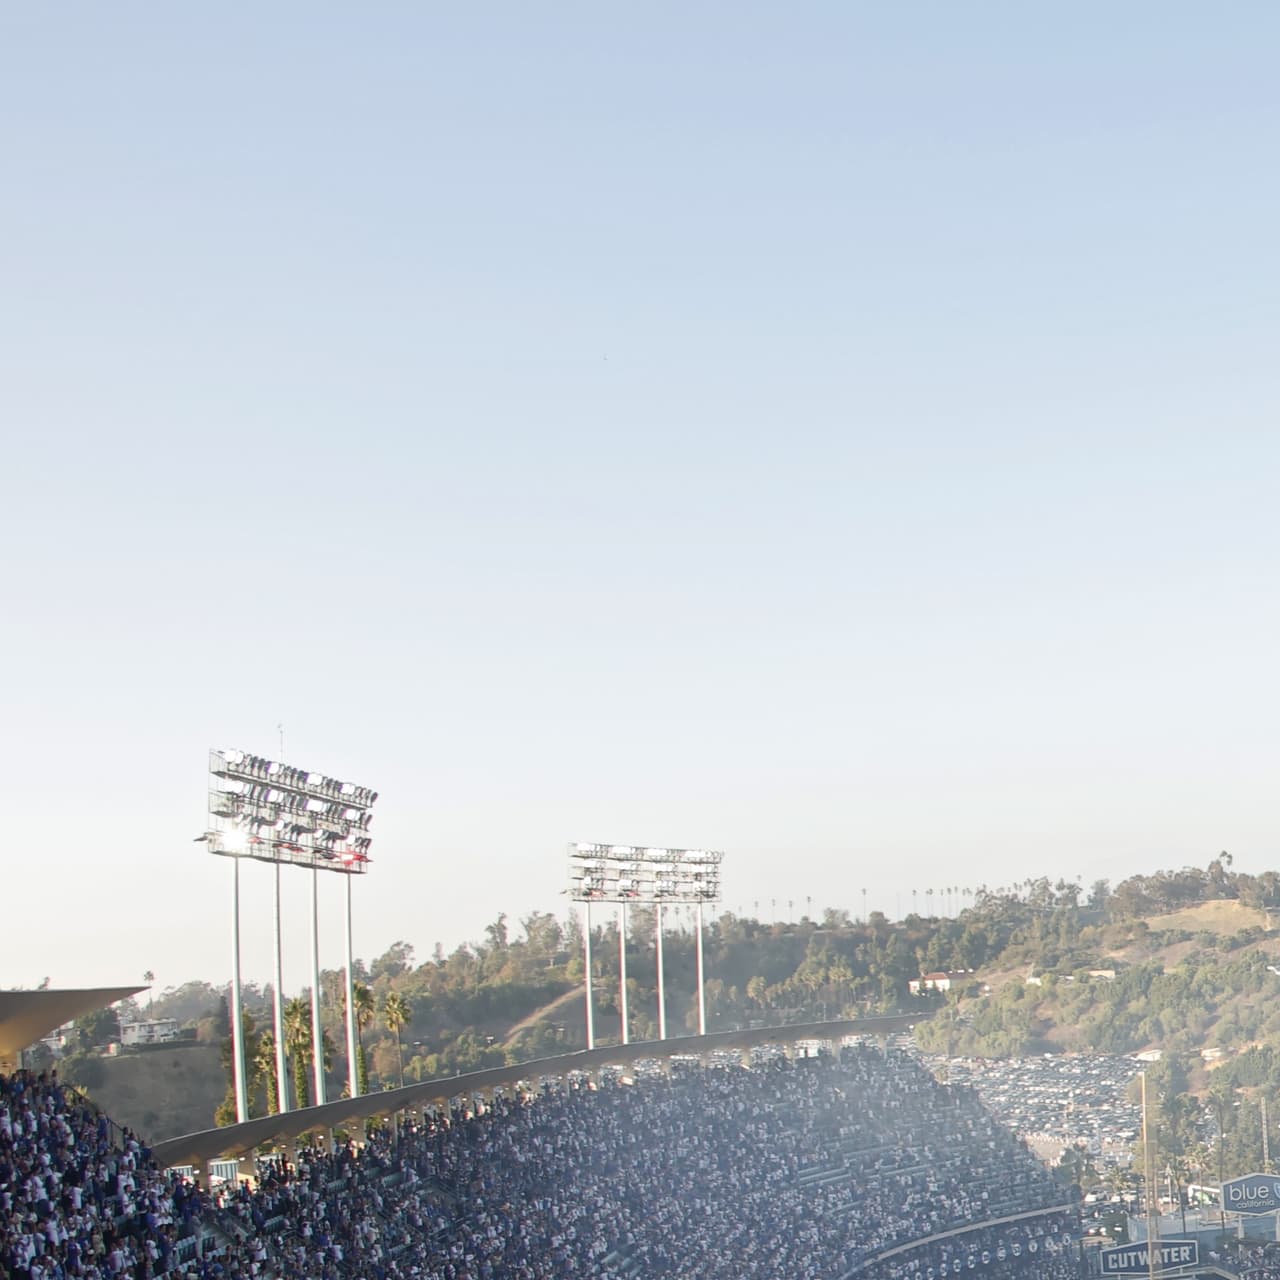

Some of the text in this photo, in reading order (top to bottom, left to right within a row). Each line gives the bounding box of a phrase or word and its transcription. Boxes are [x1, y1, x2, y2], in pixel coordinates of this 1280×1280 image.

[1229, 1183, 1269, 1200] blue
[1235, 1199, 1276, 1210] california
[1107, 1246, 1193, 1270] CUTWATER
